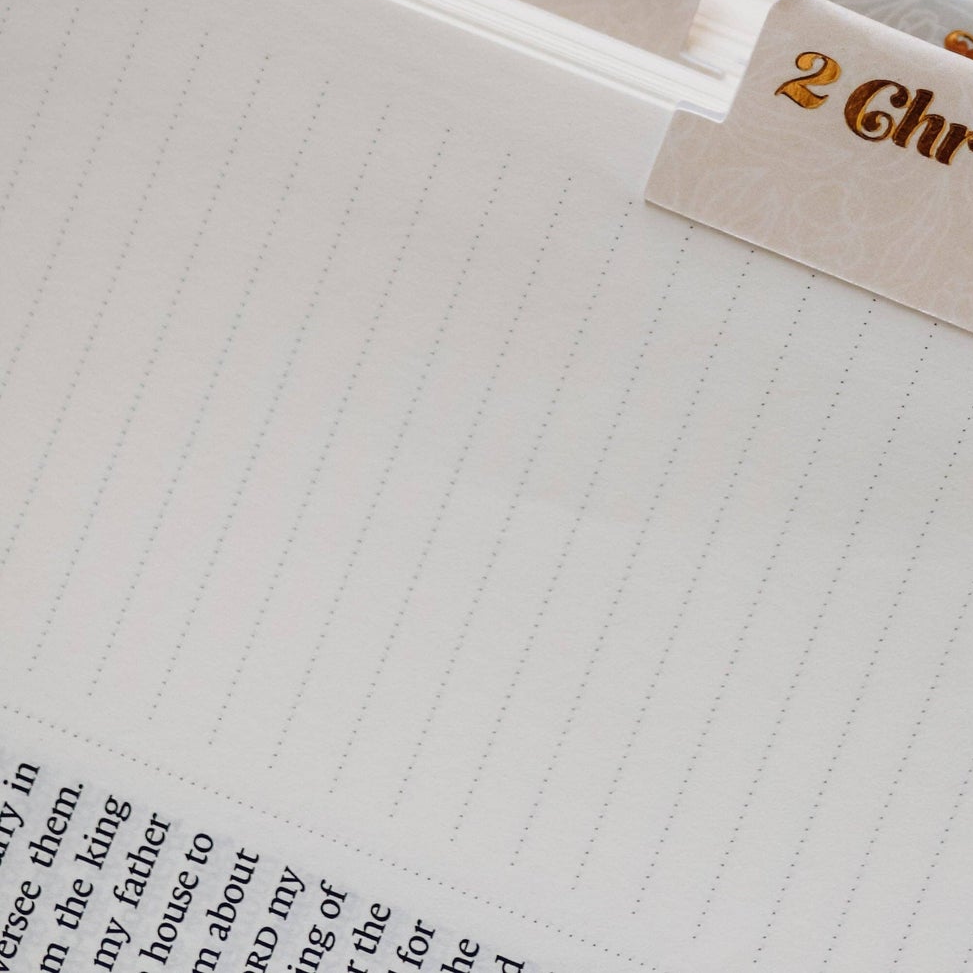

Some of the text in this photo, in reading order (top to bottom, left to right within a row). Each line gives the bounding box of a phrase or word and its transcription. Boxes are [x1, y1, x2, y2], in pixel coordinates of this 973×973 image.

[774, 51, 842, 110] 2
[3, 763, 41, 796] in
[29, 783, 84, 868] them.
[54, 879, 94, 930] the
[74, 794, 132, 870] king
[94, 813, 171, 972] my father
[139, 833, 214, 965] house to
[206, 847, 260, 941] about
[268, 866, 306, 921] my
[320, 879, 348, 919] of
[352, 903, 392, 955] the
[396, 919, 436, 970] for
